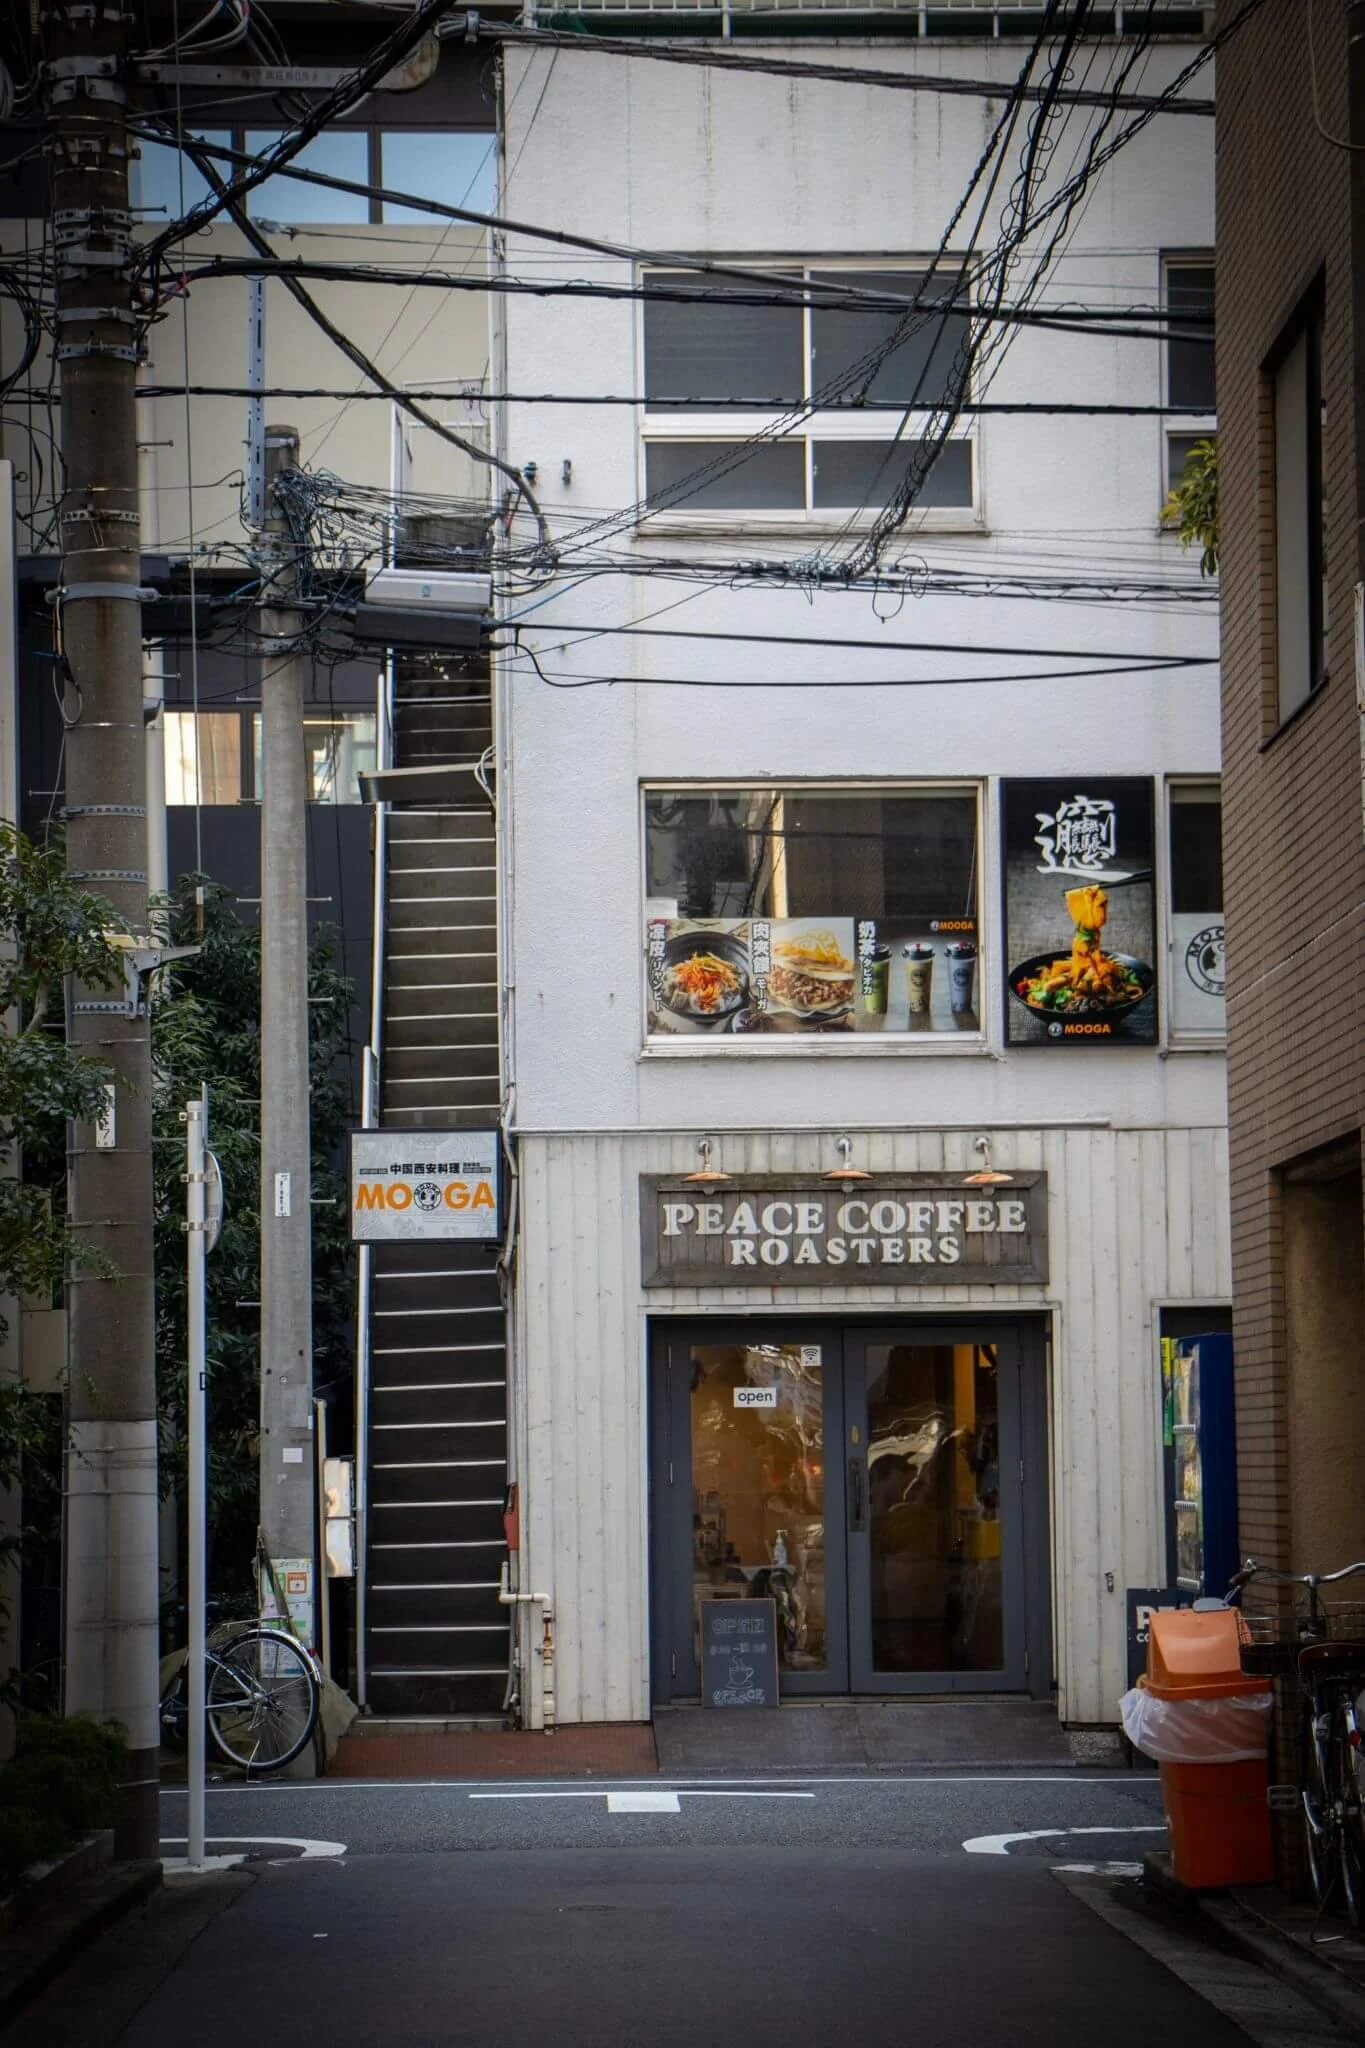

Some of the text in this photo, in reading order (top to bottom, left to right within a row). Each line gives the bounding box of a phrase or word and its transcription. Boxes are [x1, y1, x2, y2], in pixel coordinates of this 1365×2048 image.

[940, 921, 974, 930] MOOGA
[1064, 1024, 1111, 1034] MOOGA
[663, 1199, 1026, 1236] PEACE COFFEE
[730, 1236, 960, 1266] ROASTERS
[738, 1392, 773, 1404] open
